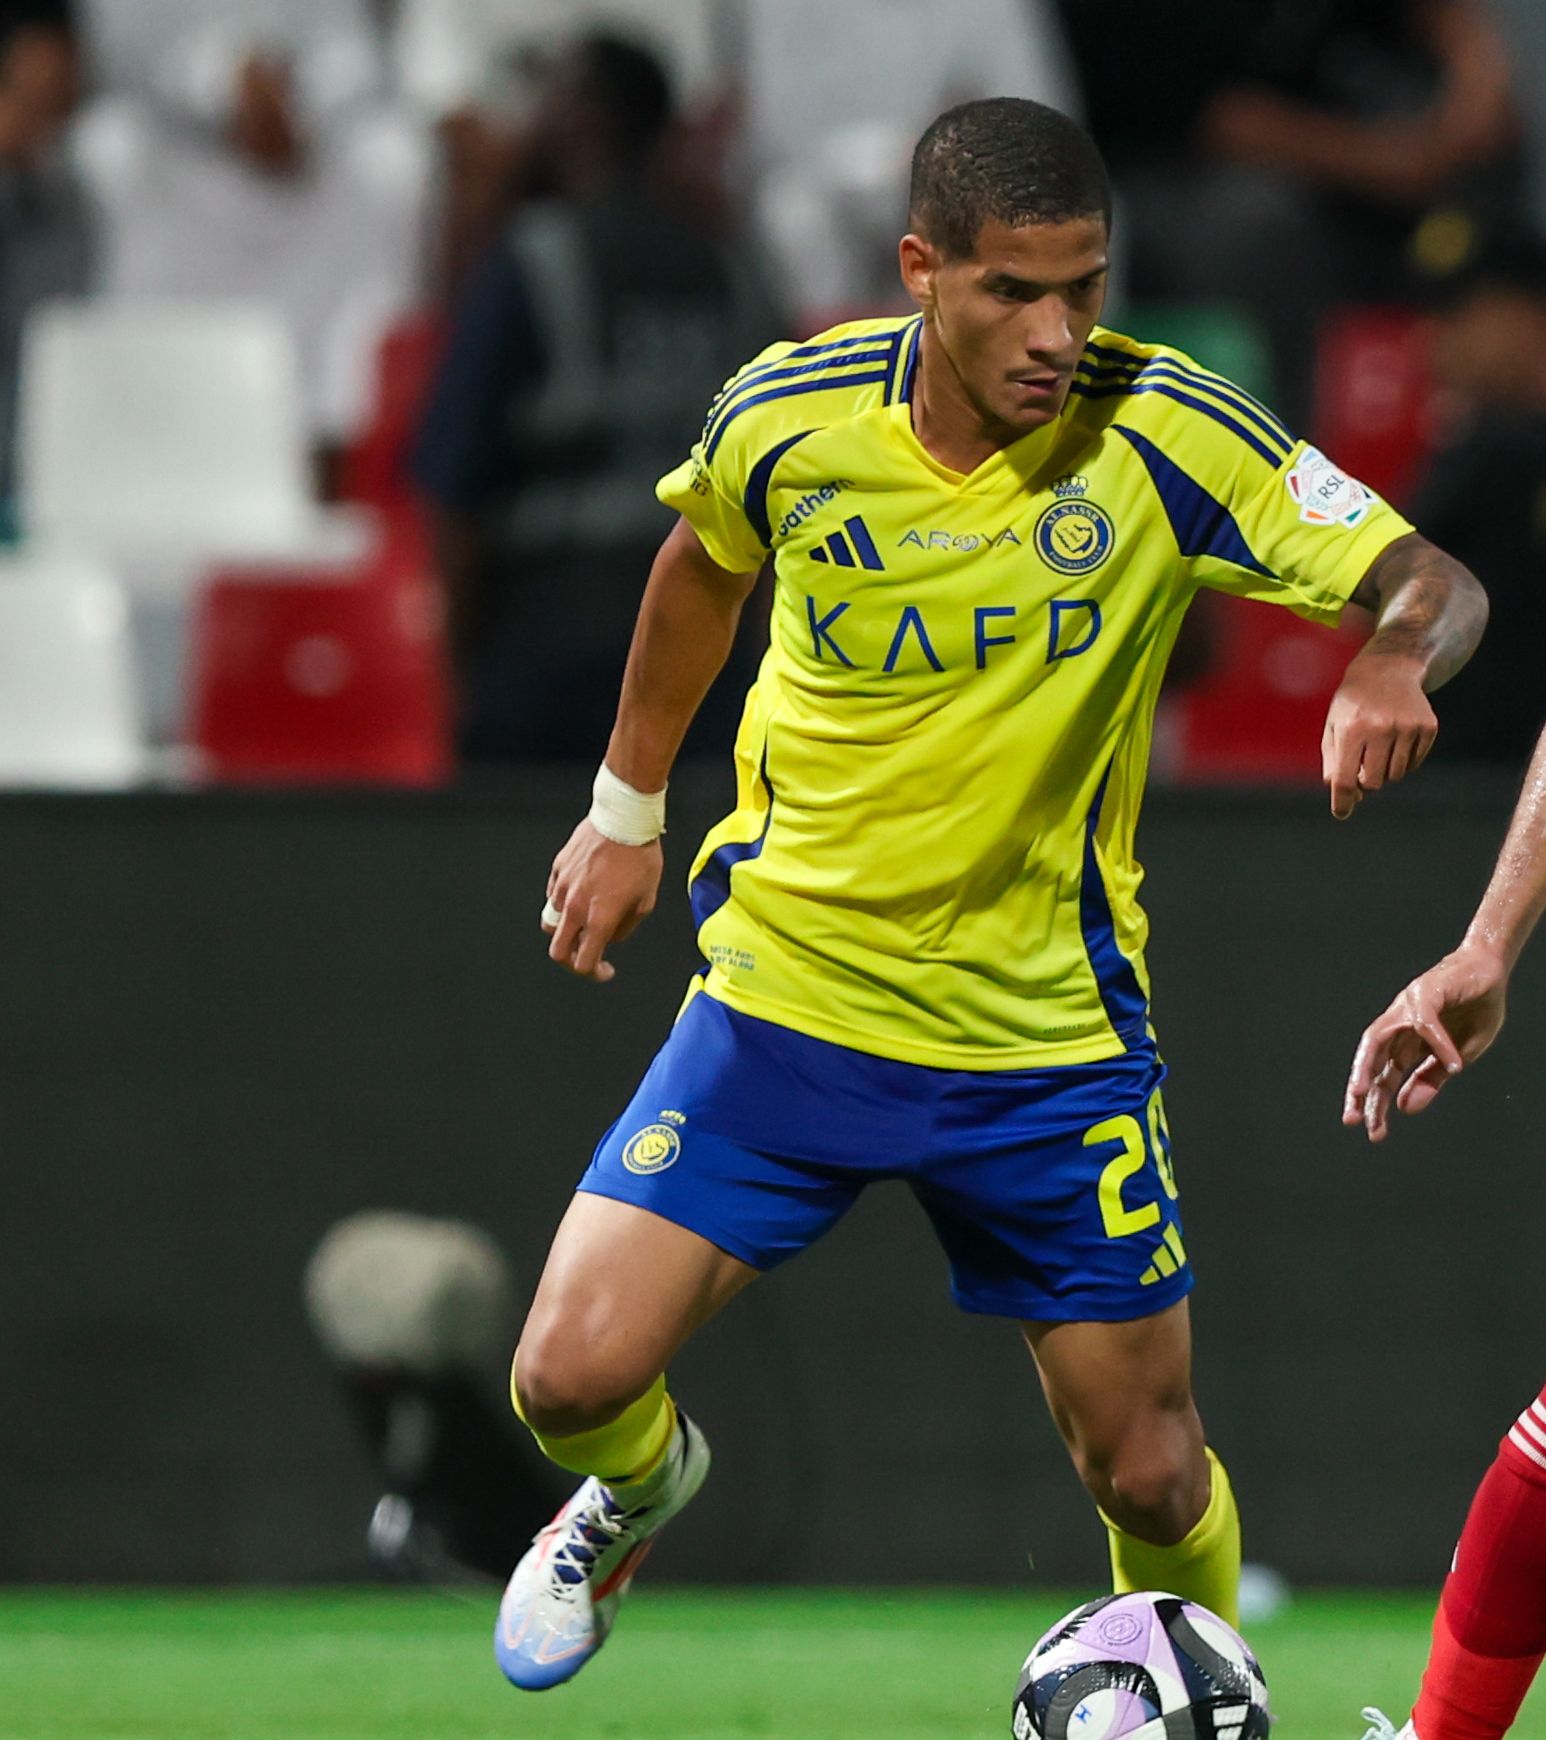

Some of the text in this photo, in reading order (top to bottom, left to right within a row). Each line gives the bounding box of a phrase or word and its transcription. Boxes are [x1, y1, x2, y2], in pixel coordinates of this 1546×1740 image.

[1316, 473, 1346, 500] RSL
[805, 595, 1103, 673] KAFD
[1082, 1085, 1179, 1239] 20
